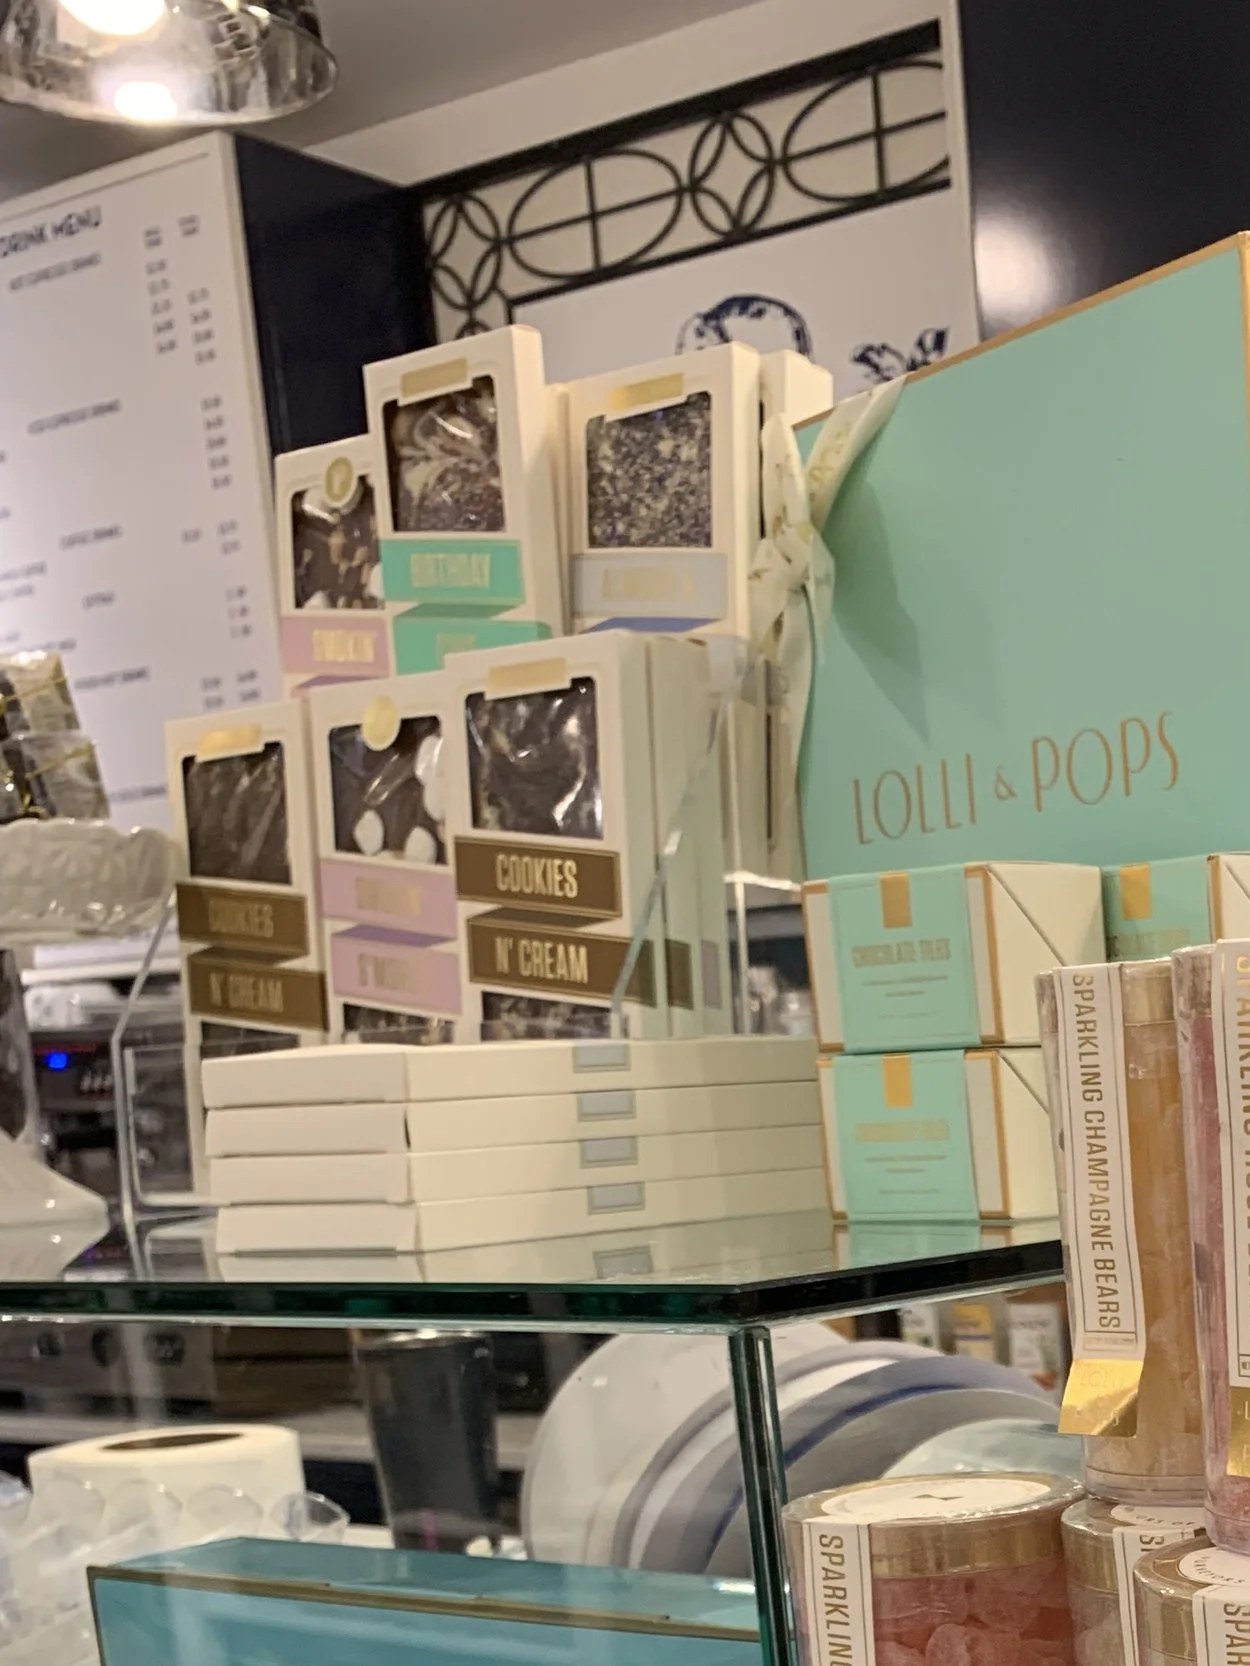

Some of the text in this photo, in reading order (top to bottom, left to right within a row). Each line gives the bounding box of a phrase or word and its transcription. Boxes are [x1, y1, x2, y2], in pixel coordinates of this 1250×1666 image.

[852, 710, 1181, 846] LOLLI & POPS
[494, 853, 579, 899] COOKIES
[493, 936, 589, 985] N' CREAM
[1071, 973, 1122, 1330] SPARKLING CHAMPAGNE BEARS
